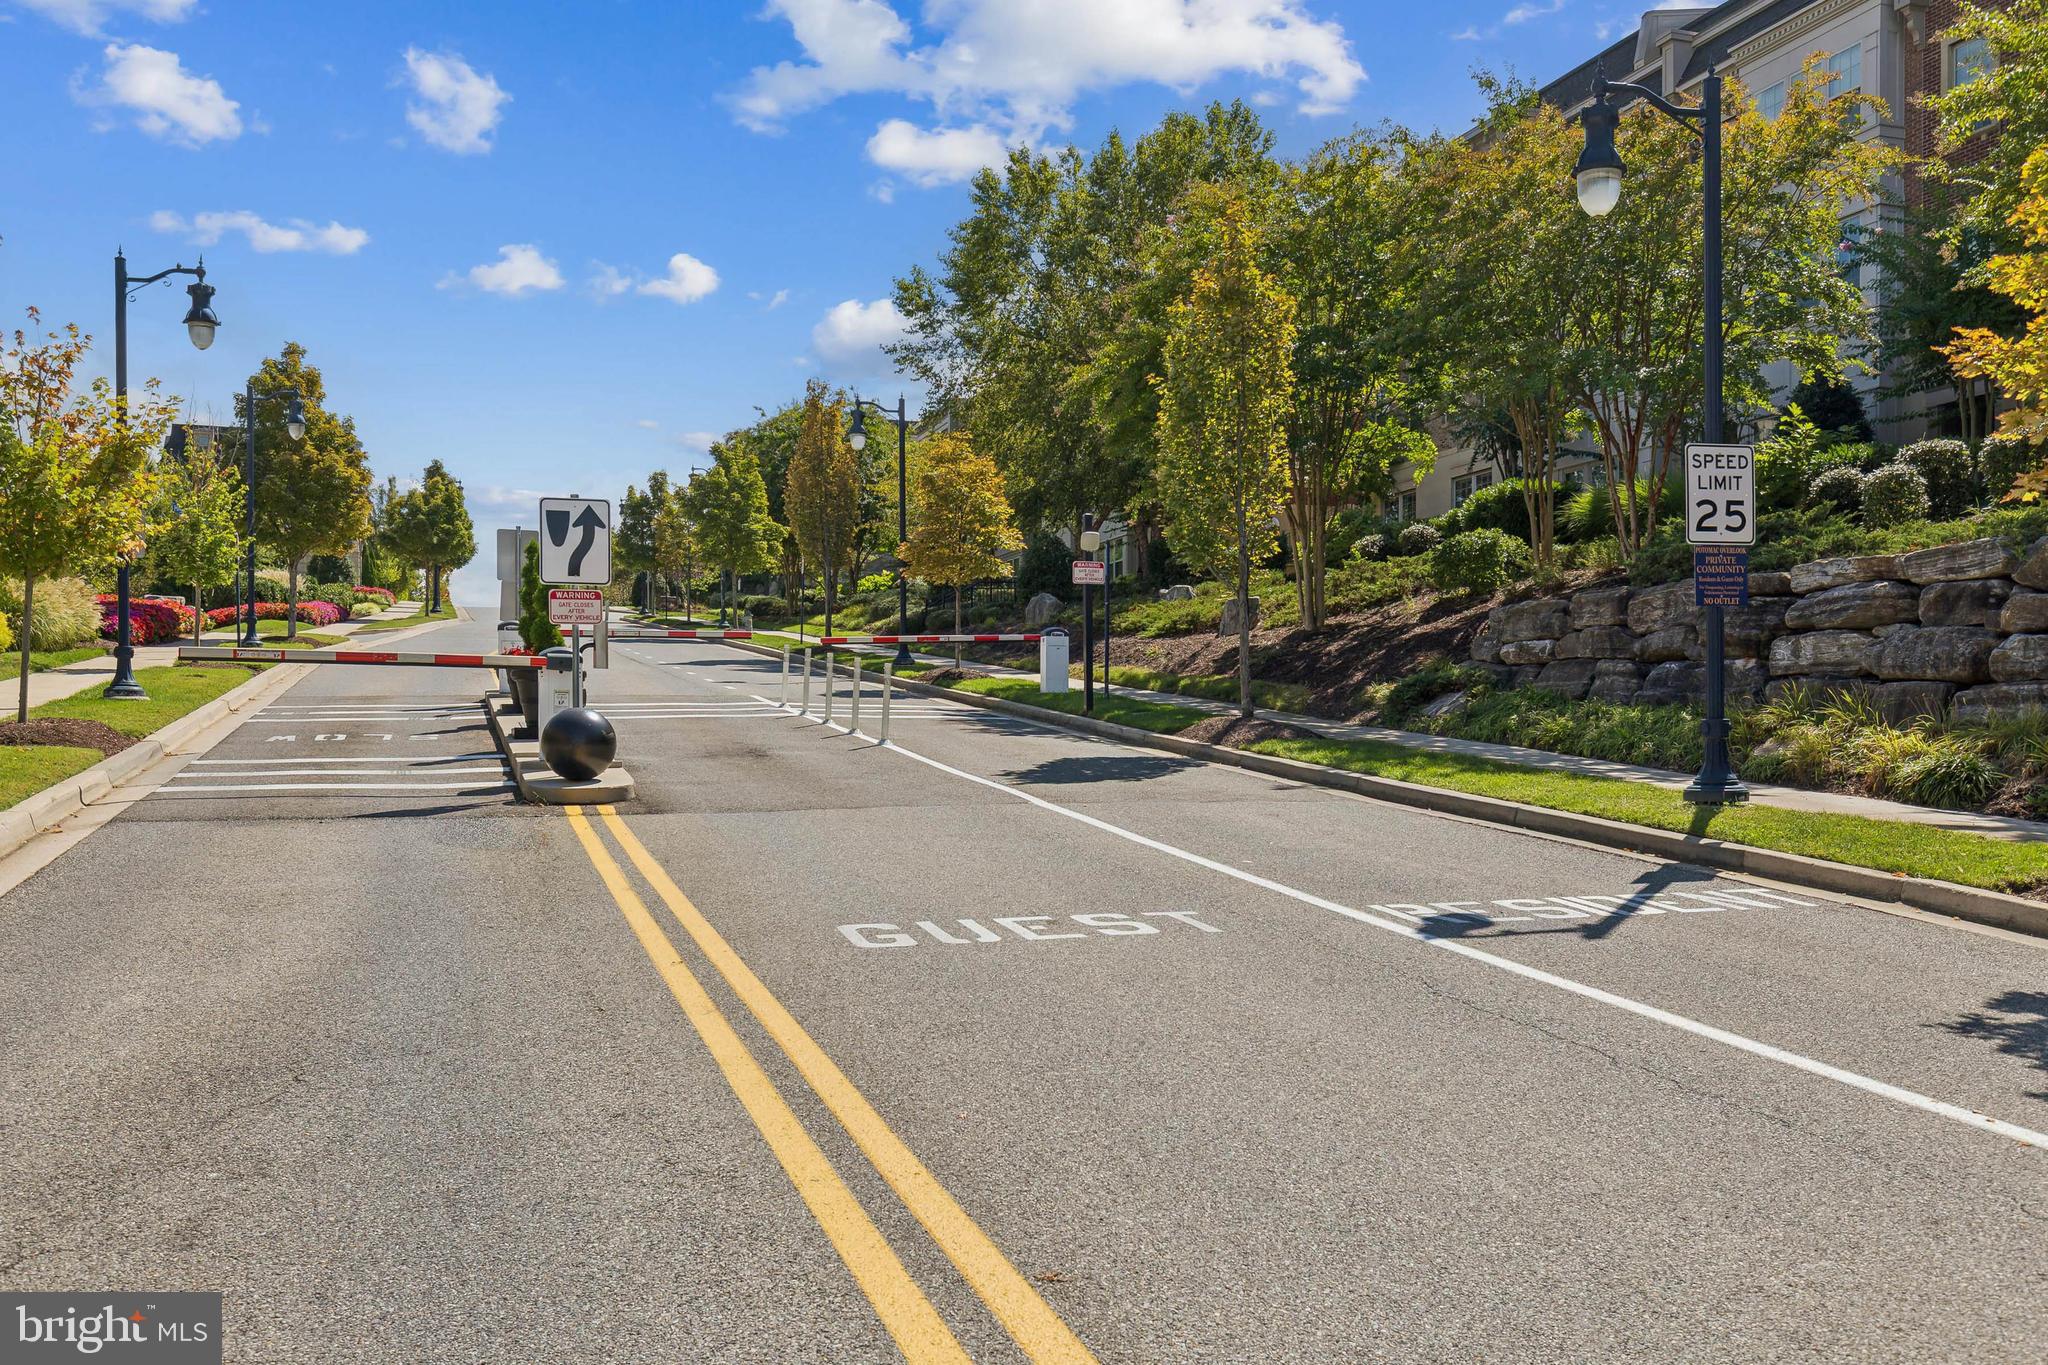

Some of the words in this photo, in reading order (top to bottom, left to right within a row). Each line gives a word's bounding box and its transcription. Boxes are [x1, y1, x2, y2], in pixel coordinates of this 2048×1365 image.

[1692, 453, 1749, 470] SPEED
[1698, 475, 1743, 490] LIMIT
[1696, 499, 1747, 533] 25
[1705, 556, 1737, 565] PRIVATE
[1696, 565, 1746, 574] COMMUNITY
[555, 591, 596, 599] WARNING
[1703, 597, 1714, 605] NO
[1714, 597, 1739, 605] OUTLET
[1368, 888, 1820, 925] RESIDENT
[836, 911, 1224, 949] GUEST
